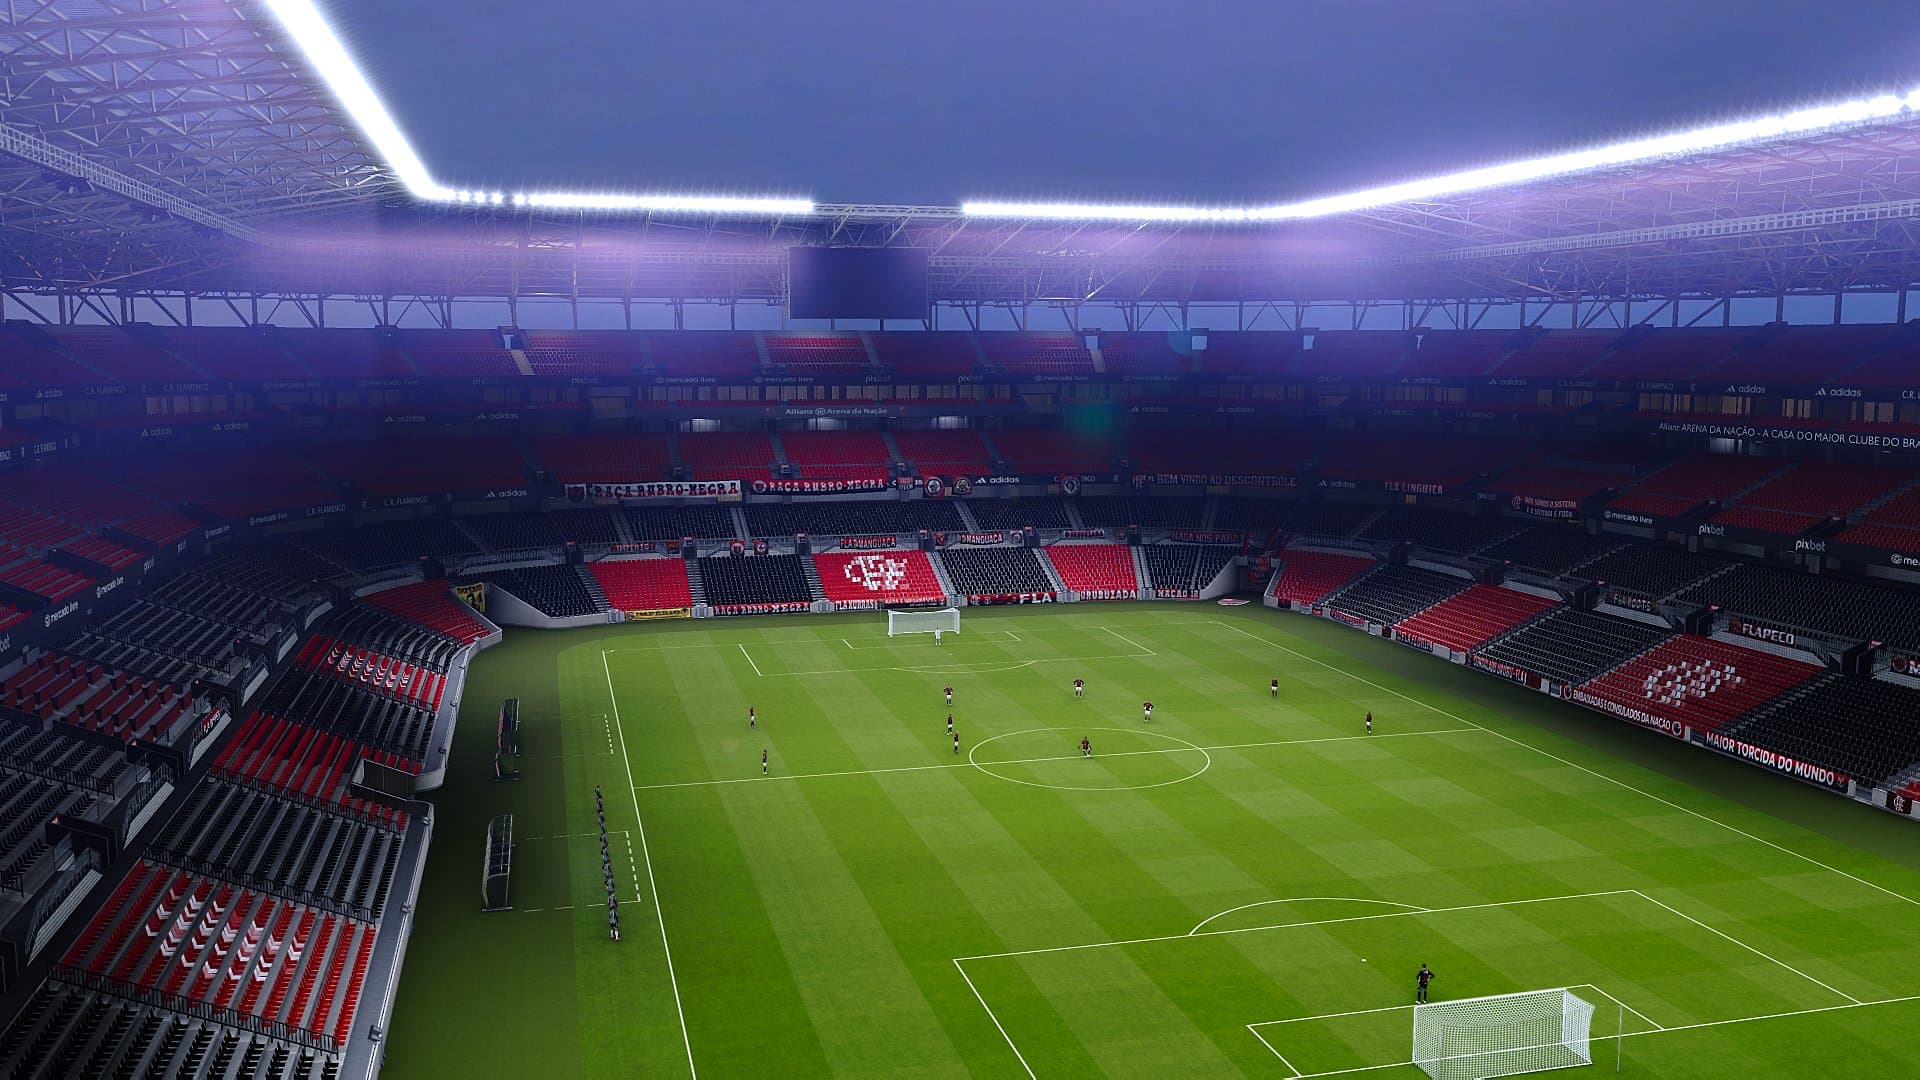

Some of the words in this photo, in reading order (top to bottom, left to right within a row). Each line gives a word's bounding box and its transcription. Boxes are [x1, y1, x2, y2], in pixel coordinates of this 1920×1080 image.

[1738, 384, 1766, 394] adidas
[1830, 387, 1861, 399] adidas
[490, 411, 519, 420] adidas
[1681, 423, 1707, 433] ARENA
[1710, 425, 1722, 435] DA
[1724, 425, 1755, 438] NAÇÃO
[1771, 429, 1795, 441] CASA
[1797, 431, 1813, 441] DO
[1815, 432, 1846, 443] MAIOR
[1849, 434, 1881, 446] CLUBE
[1883, 436, 1900, 447] DO
[989, 475, 1019, 485] adidas
[1330, 480, 1356, 489] adidas
[498, 488, 528, 498] adidas
[1611, 511, 1639, 523] mercado
[1640, 514, 1653, 525] livre
[1020, 591, 1053, 605] FLA
[1572, 689, 1604, 709] EMBAIXADAS
[1607, 700, 1641, 721] CONSULADOS
[1641, 712, 1651, 723] DA
[1706, 731, 1735, 754] MAIOR
[1737, 741, 1776, 769] TORCIDA
[1777, 756, 1793, 774] DO
[1794, 761, 1834, 786] MUNDO
